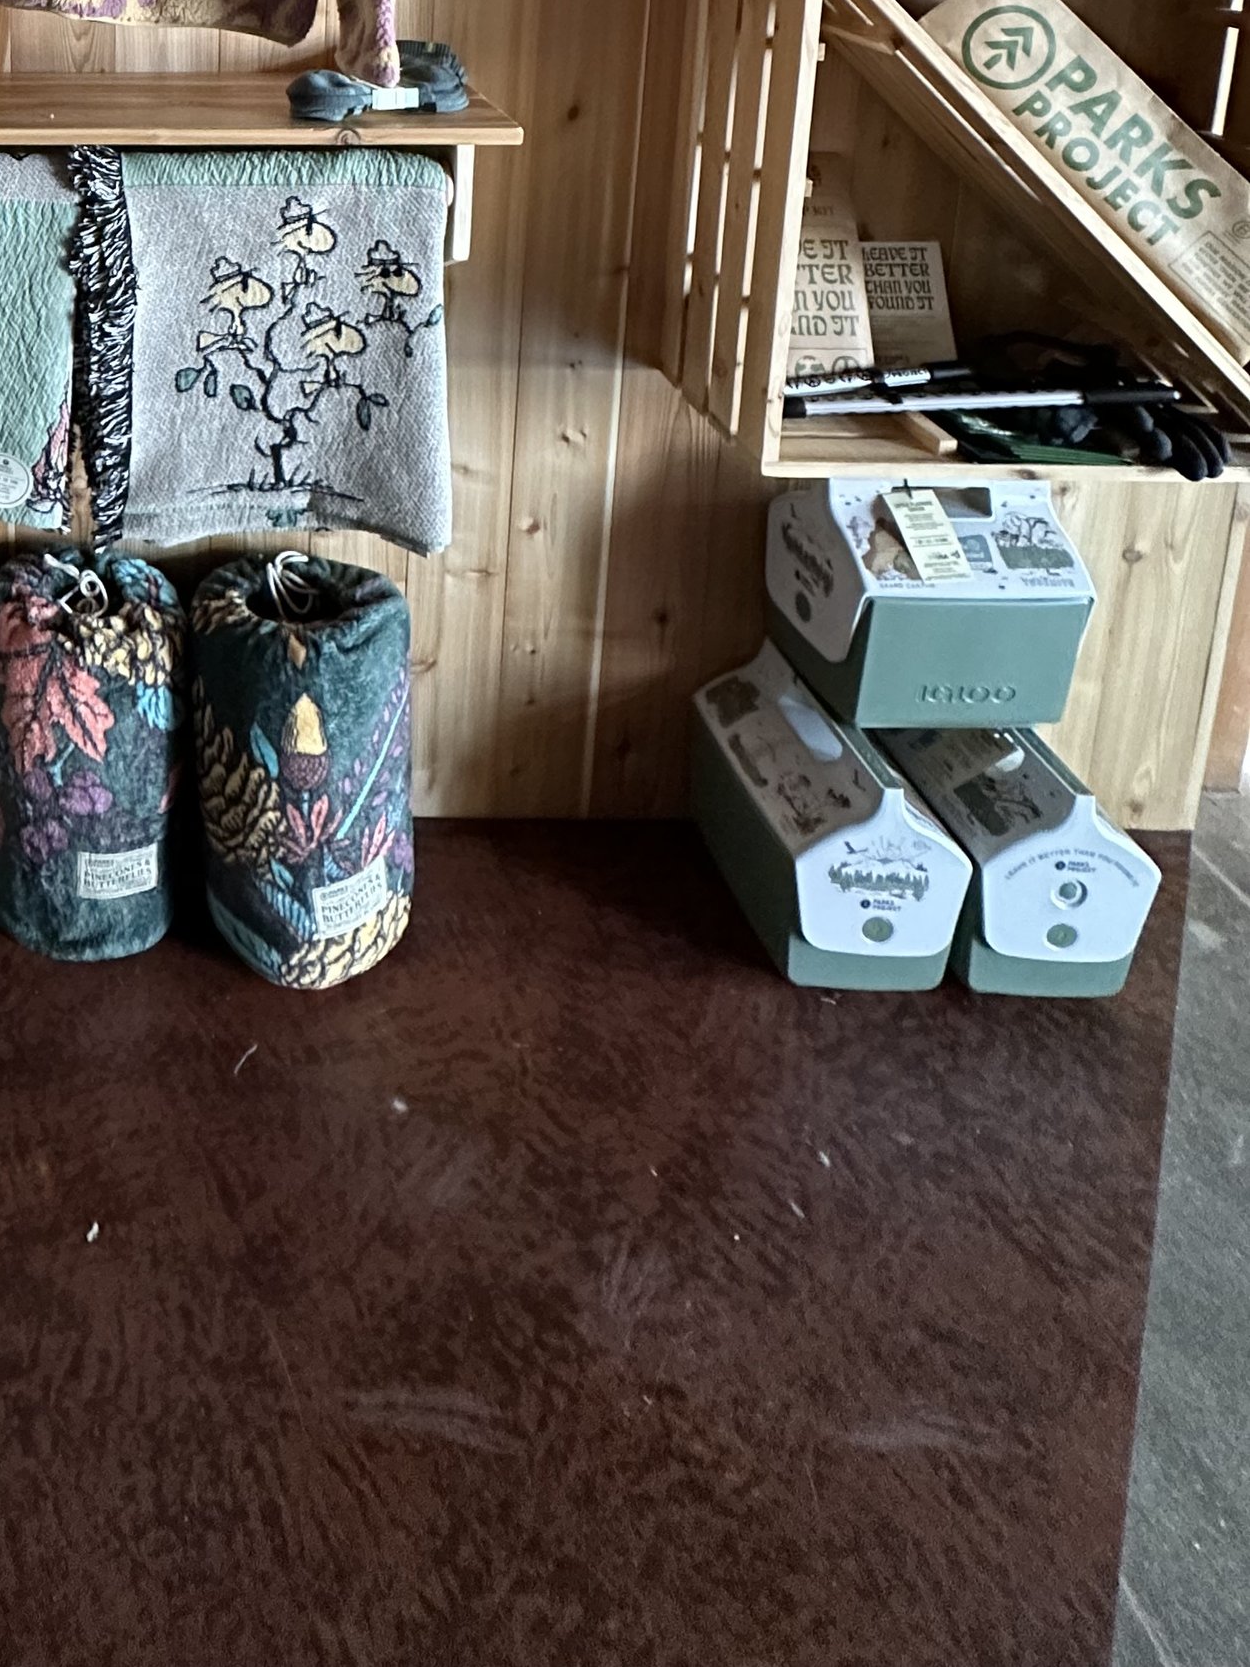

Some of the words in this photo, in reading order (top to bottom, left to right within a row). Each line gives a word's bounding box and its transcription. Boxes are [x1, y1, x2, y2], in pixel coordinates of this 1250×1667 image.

[1044, 54, 1222, 220] PARKS
[1012, 89, 1181, 247] PROJECT
[820, 239, 849, 261] IT
[862, 246, 906, 262] LEAVE
[908, 247, 928, 262] IT
[797, 263, 854, 285] TER
[864, 262, 931, 278] BETTER
[864, 280, 903, 295] THAN
[904, 280, 932, 295] YOU
[813, 289, 856, 312] YOU
[868, 295, 916, 311] FOUND
[916, 296, 935, 311] IT
[831, 315, 860, 337] IT
[915, 684, 1017, 704] IGLOO
[83, 867, 152, 888] BUTTERFLIES
[84, 861, 142, 881] PINECONES
[321, 879, 374, 914] PINECONES
[322, 882, 382, 923] BUTTERFLIES
